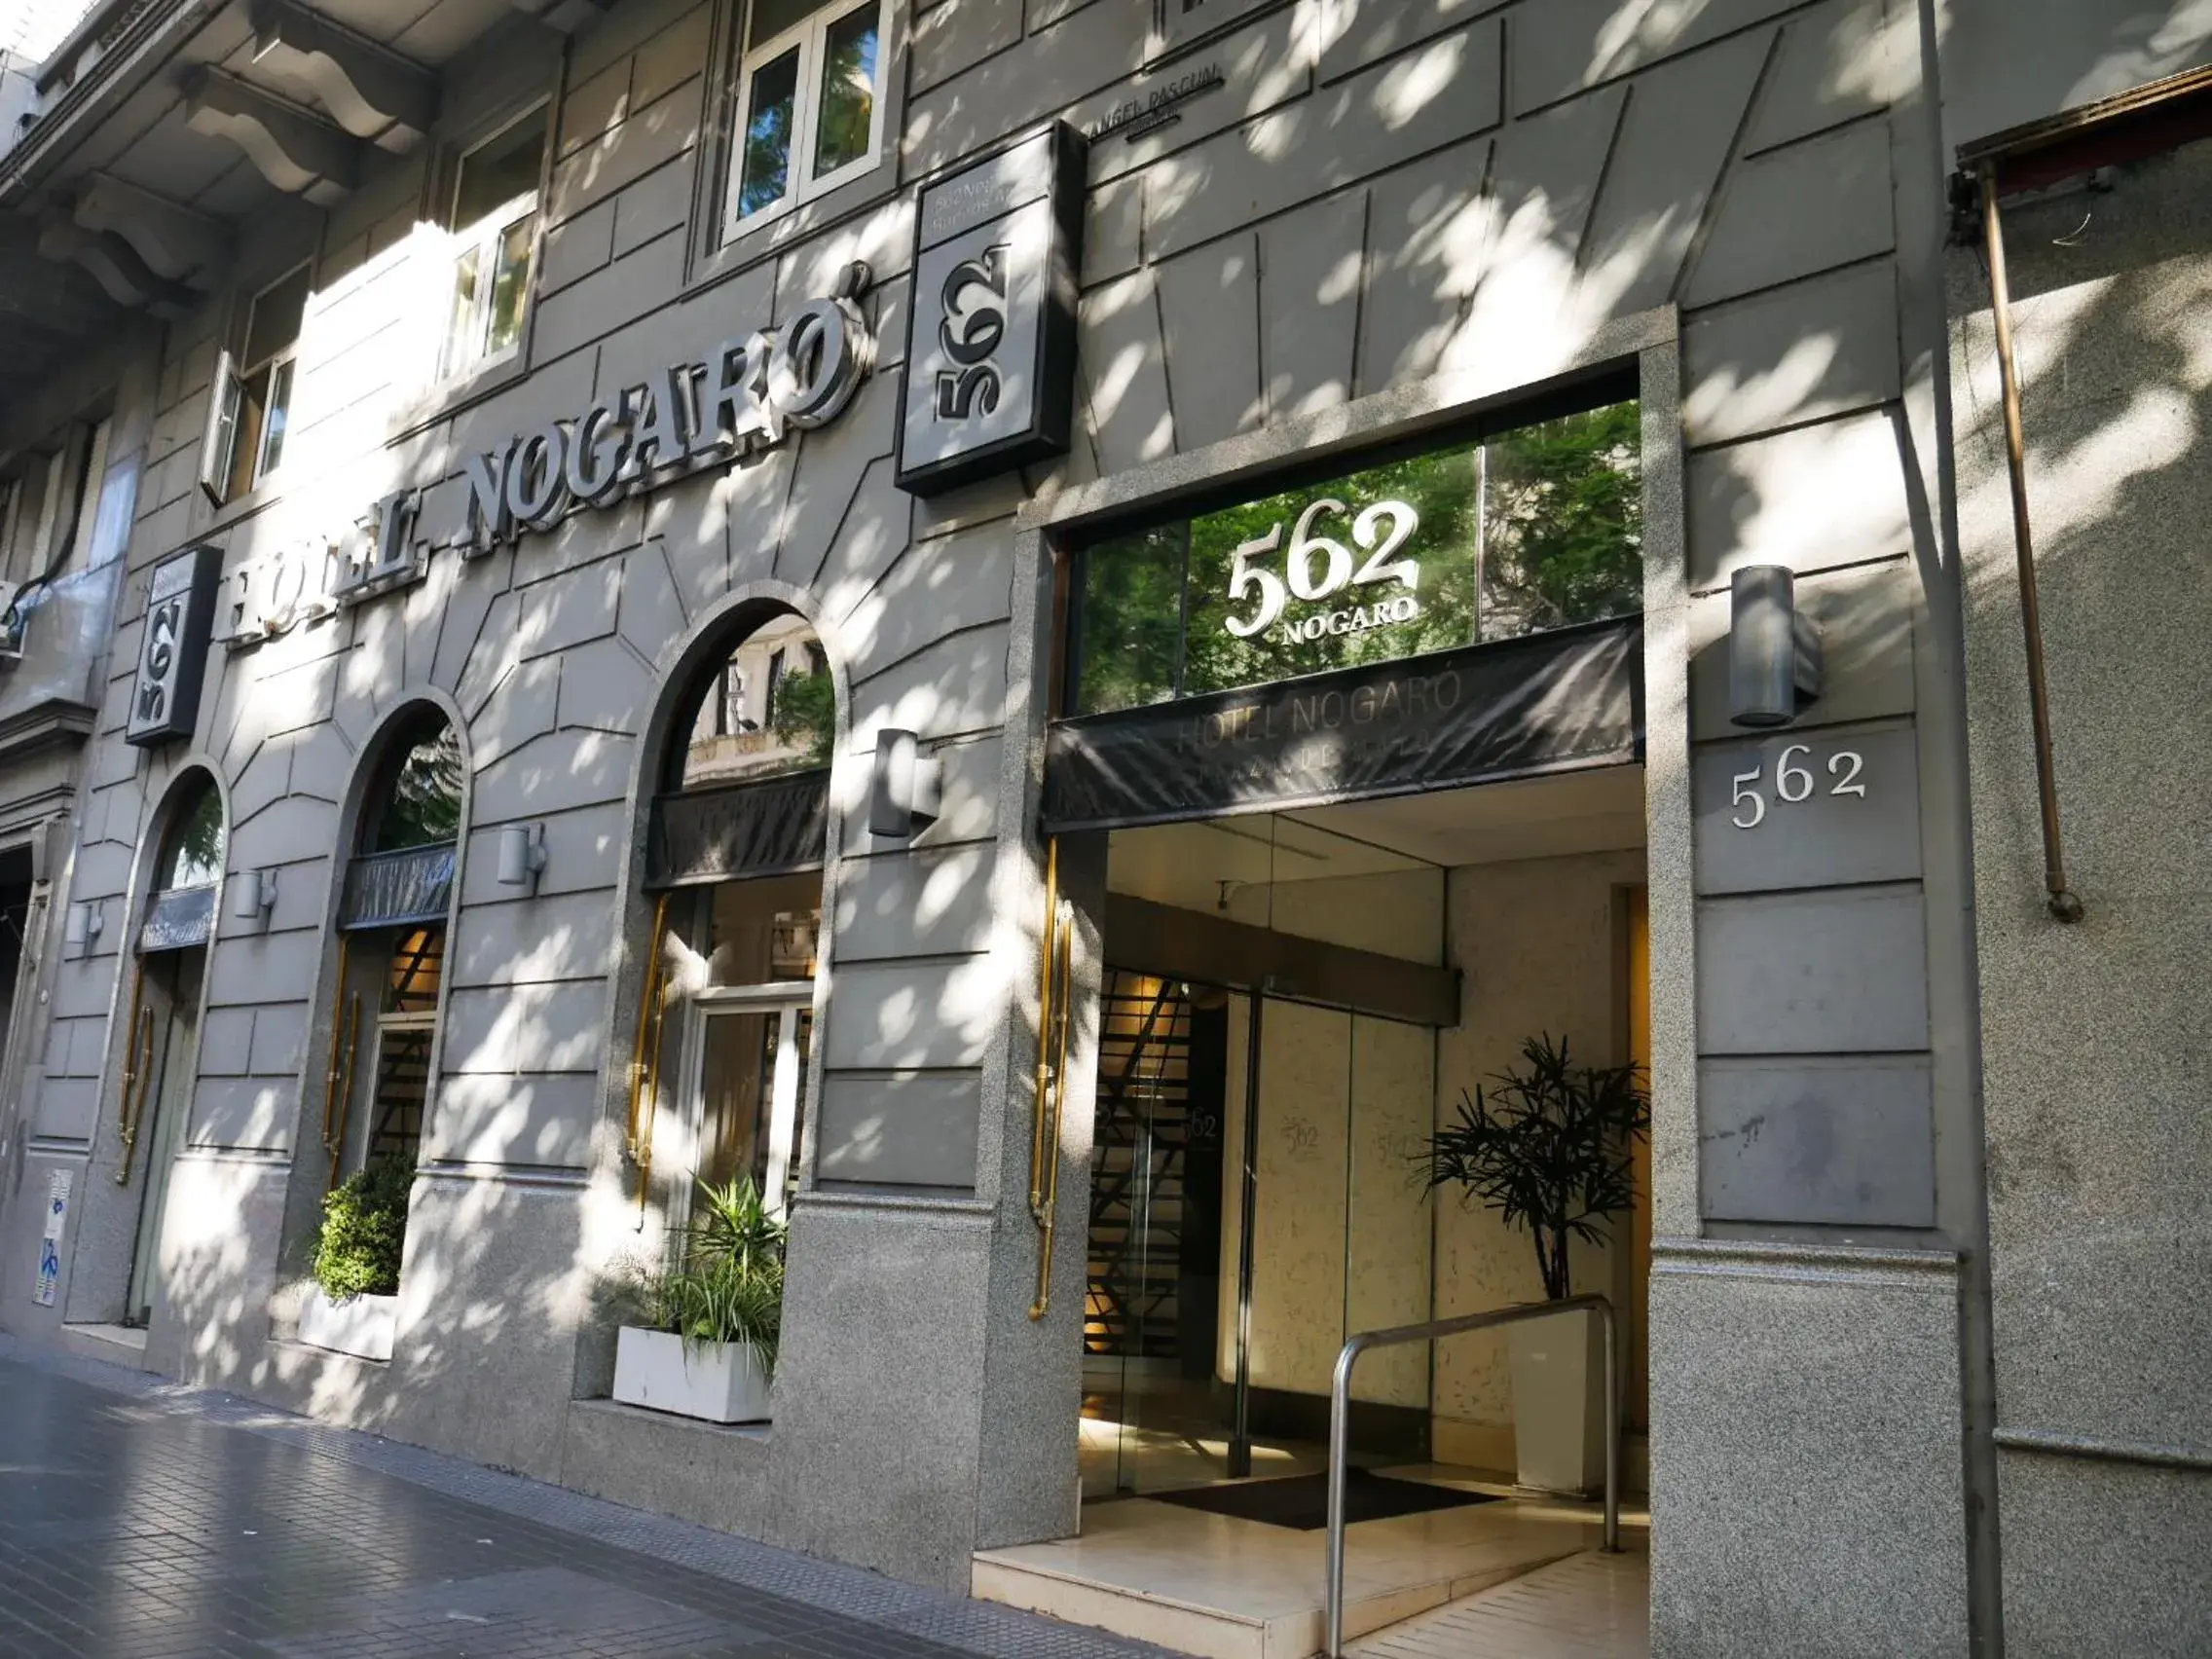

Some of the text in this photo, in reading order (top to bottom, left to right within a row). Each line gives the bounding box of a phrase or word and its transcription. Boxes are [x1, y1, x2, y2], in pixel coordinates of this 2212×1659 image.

[933, 243, 1012, 424] 562
[1224, 498, 1419, 637] 562
[136, 598, 182, 722] 562
[1280, 595, 1419, 646] NOGARO
[1175, 703, 1279, 754] HOTEL
[1732, 745, 1865, 829] 562
